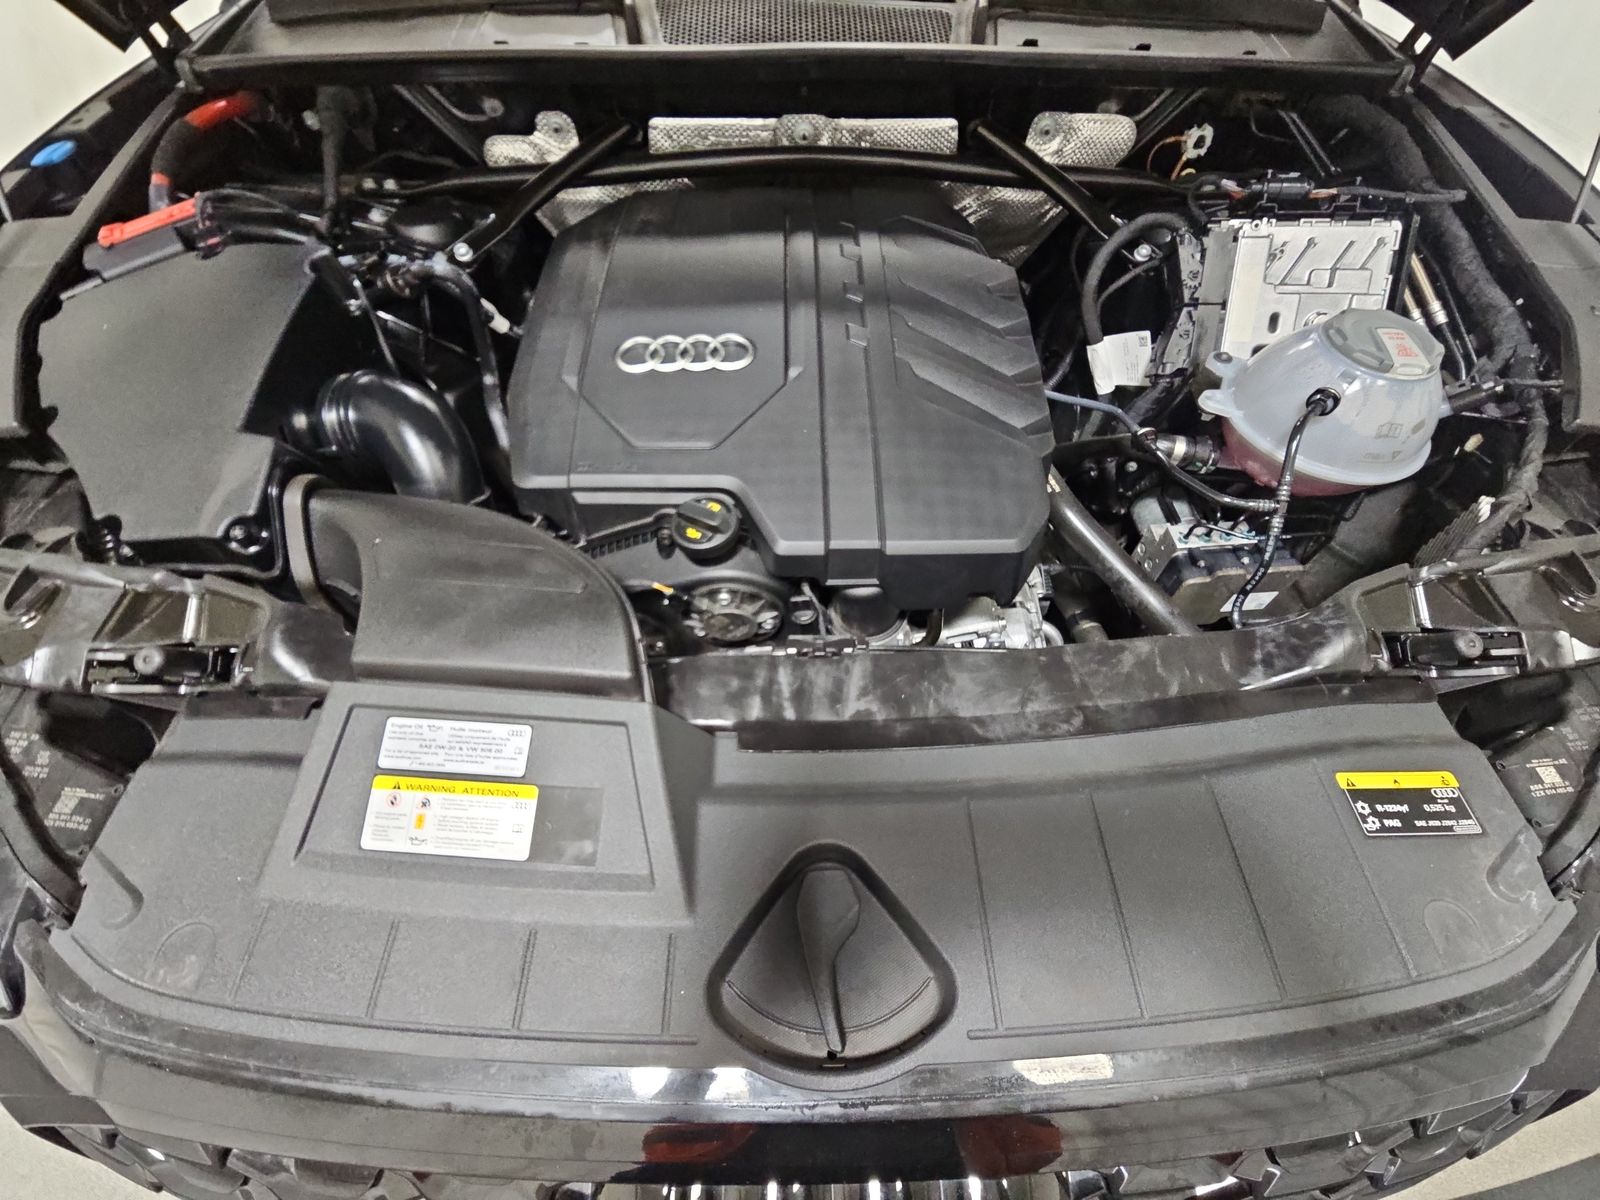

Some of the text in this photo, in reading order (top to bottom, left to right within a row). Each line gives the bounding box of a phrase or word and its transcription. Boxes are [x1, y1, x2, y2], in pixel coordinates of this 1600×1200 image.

[405, 782, 520, 798] WARNING ATTENTION
[1375, 804, 1410, 814] R-1234yf
[1382, 819, 1402, 827] PAG
